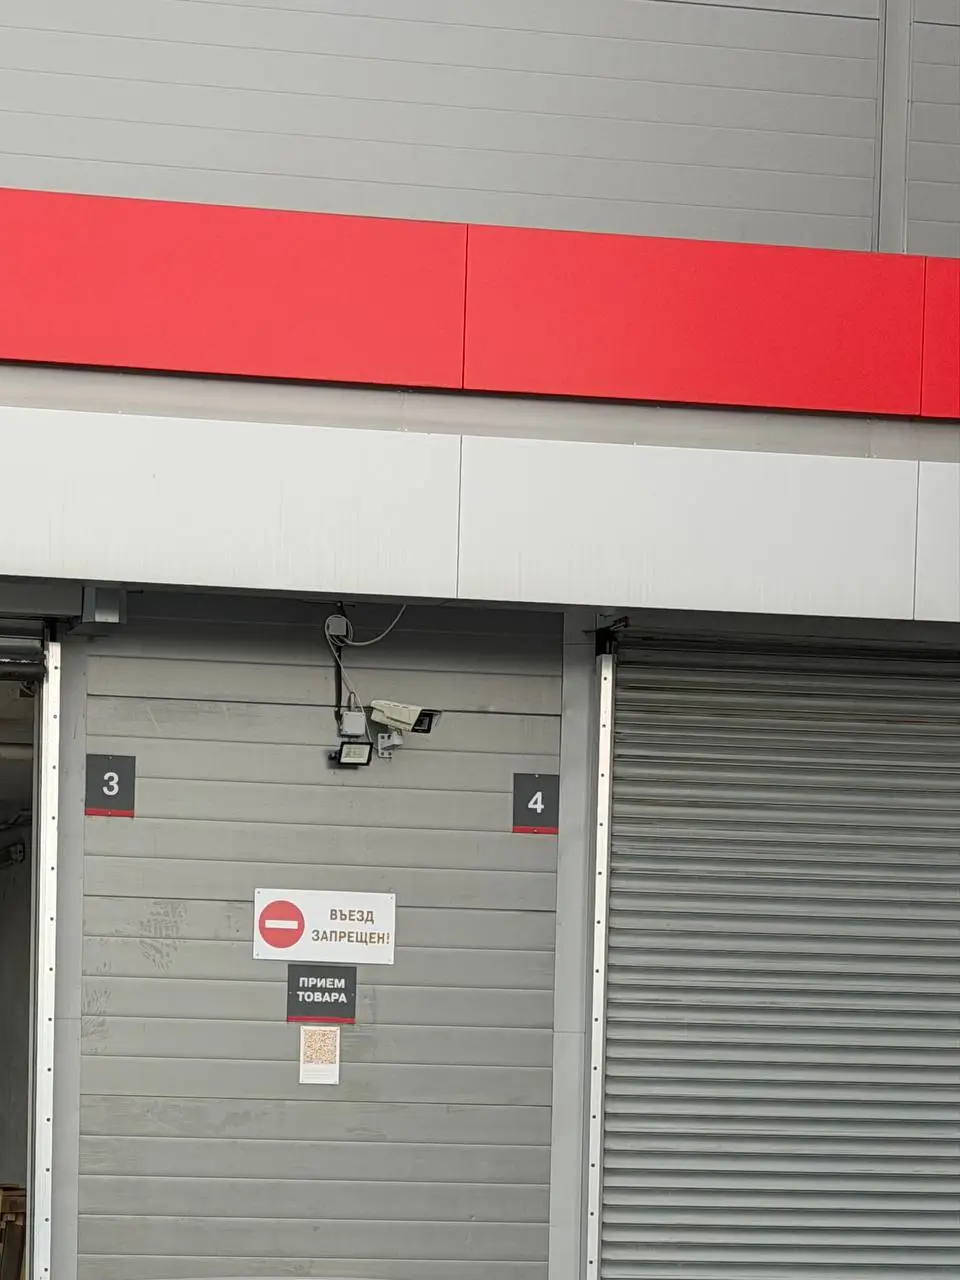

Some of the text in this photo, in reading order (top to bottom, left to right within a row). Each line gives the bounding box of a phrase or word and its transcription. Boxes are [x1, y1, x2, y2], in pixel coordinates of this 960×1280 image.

[102, 771, 119, 796] 3
[527, 791, 545, 813] 4
[329, 908, 375, 924] ВЪЕЗД
[311, 929, 390, 945] ЗАПРЕЩЕН!
[299, 977, 346, 989] ПРИЕМ
[296, 991, 348, 1003] ТОВАРА
